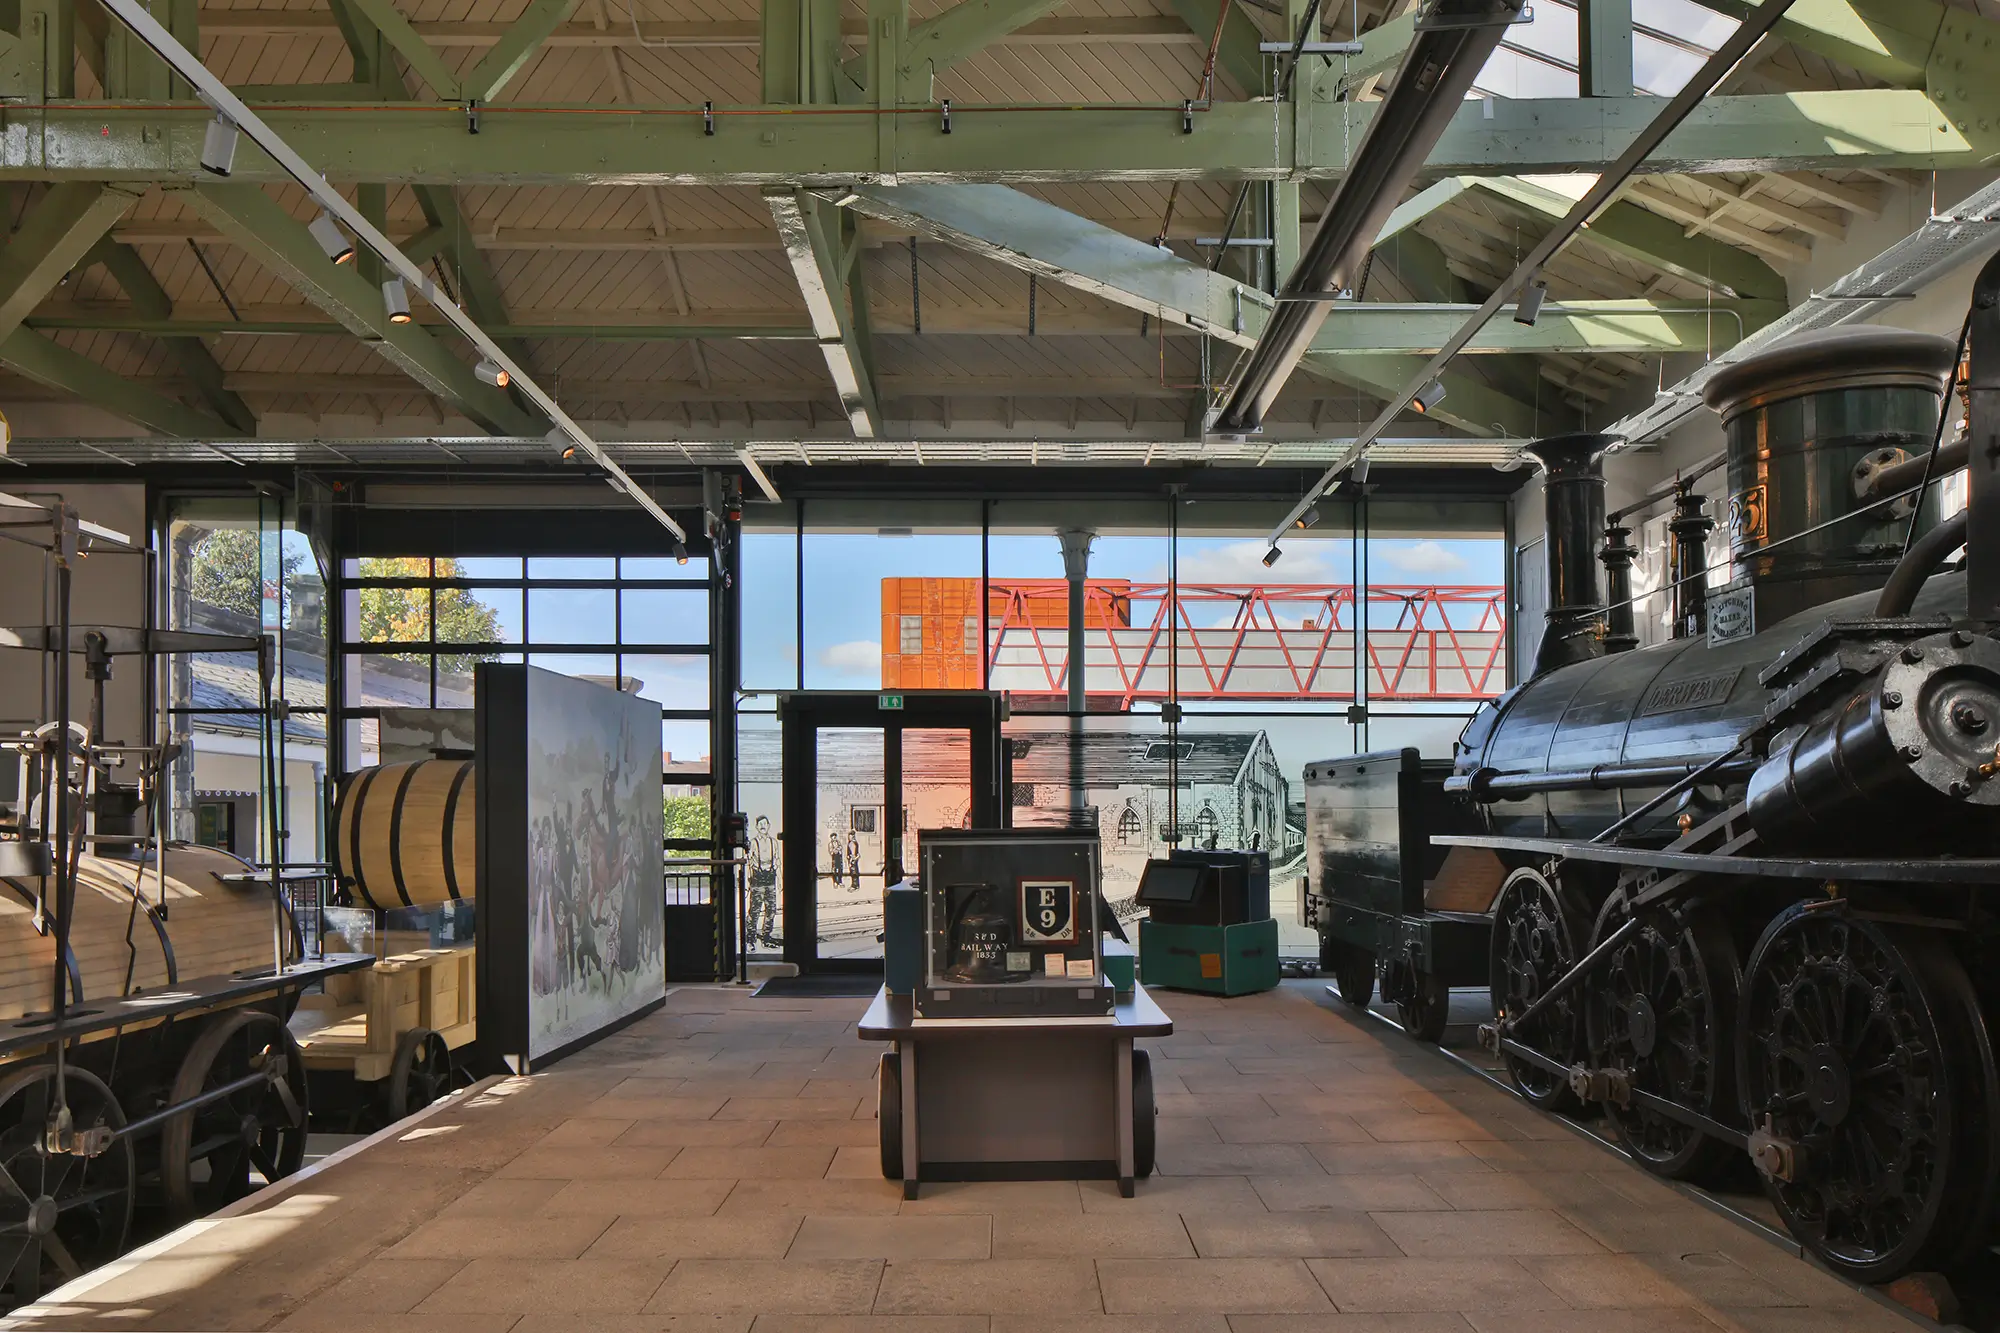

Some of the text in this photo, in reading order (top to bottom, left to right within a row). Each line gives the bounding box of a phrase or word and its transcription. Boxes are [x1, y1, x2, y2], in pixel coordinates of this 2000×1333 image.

[1729, 491, 1760, 540] 25
[1648, 671, 1737, 709] DERWENT
[1039, 888, 1055, 907] E
[1040, 909, 1056, 928] 9
[990, 933, 997, 941] D
